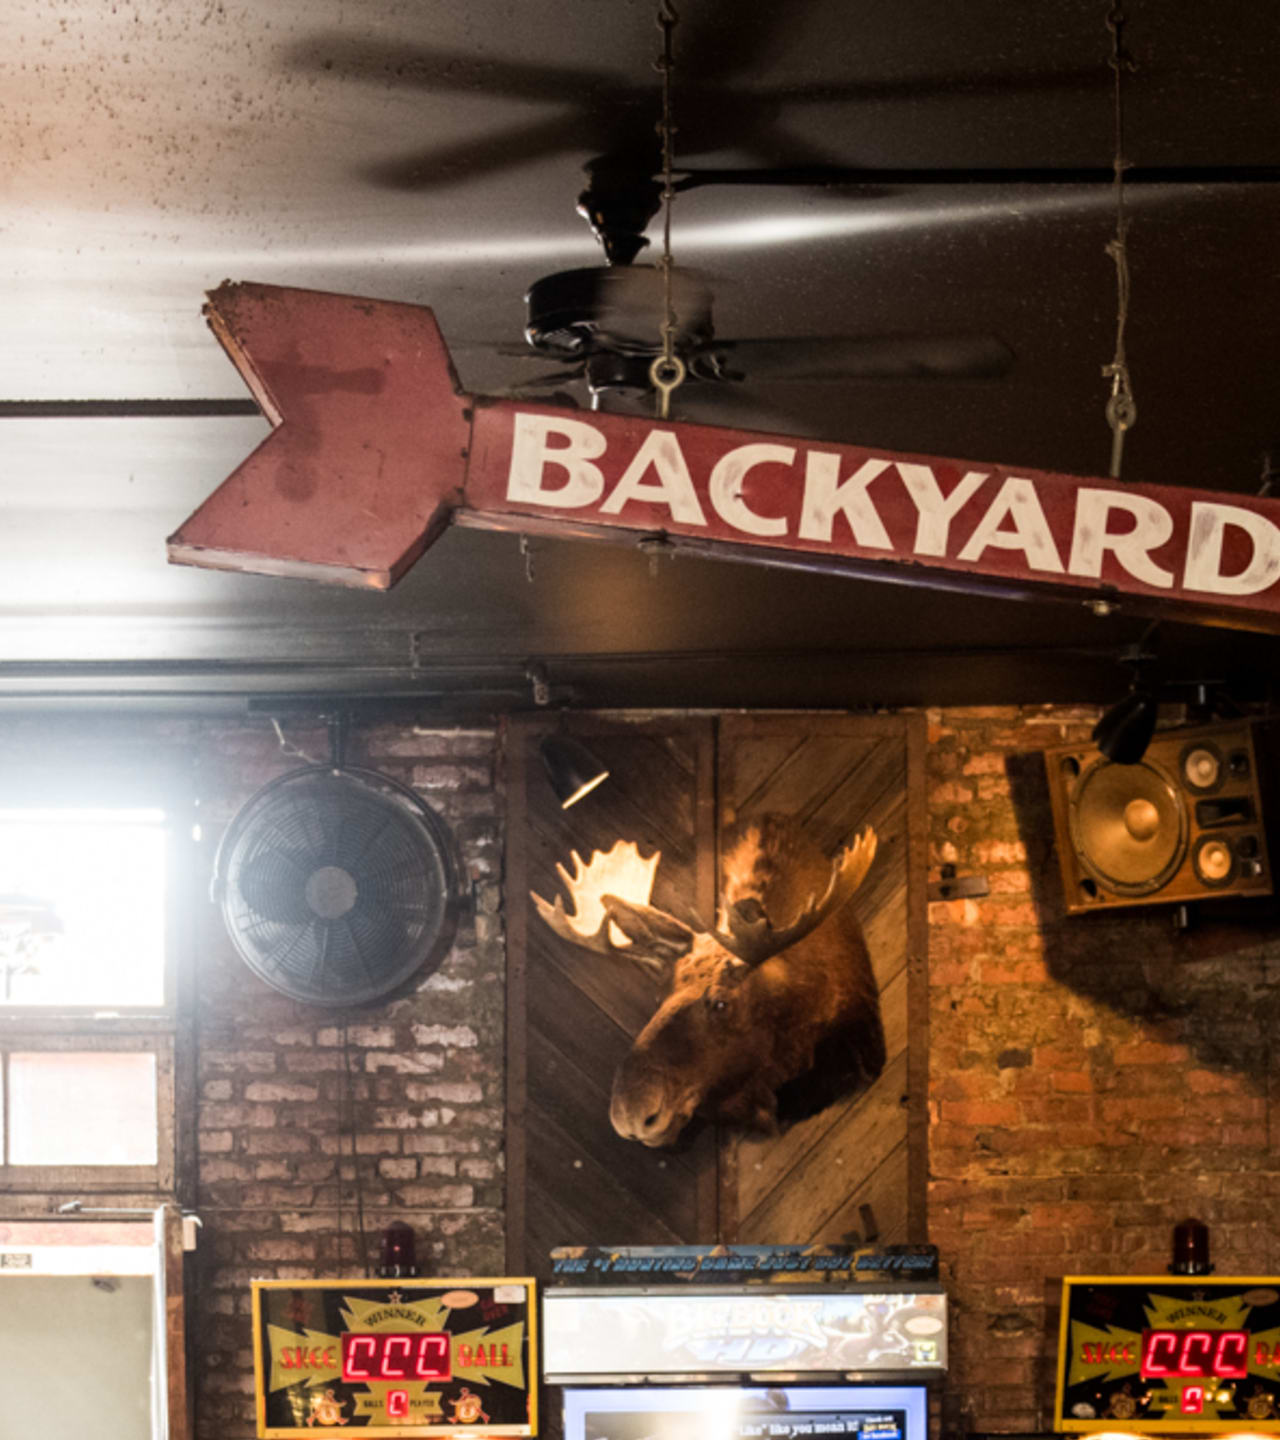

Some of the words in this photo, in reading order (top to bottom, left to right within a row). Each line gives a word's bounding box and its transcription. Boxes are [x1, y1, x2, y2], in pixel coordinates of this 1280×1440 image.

[363, 1307, 426, 1327] WINNER
[1166, 1304, 1227, 1324] WINNER
[280, 1346, 337, 1370] SKEE
[458, 1343, 513, 1368] BALL
[1081, 1341, 1136, 1365] SKEE
